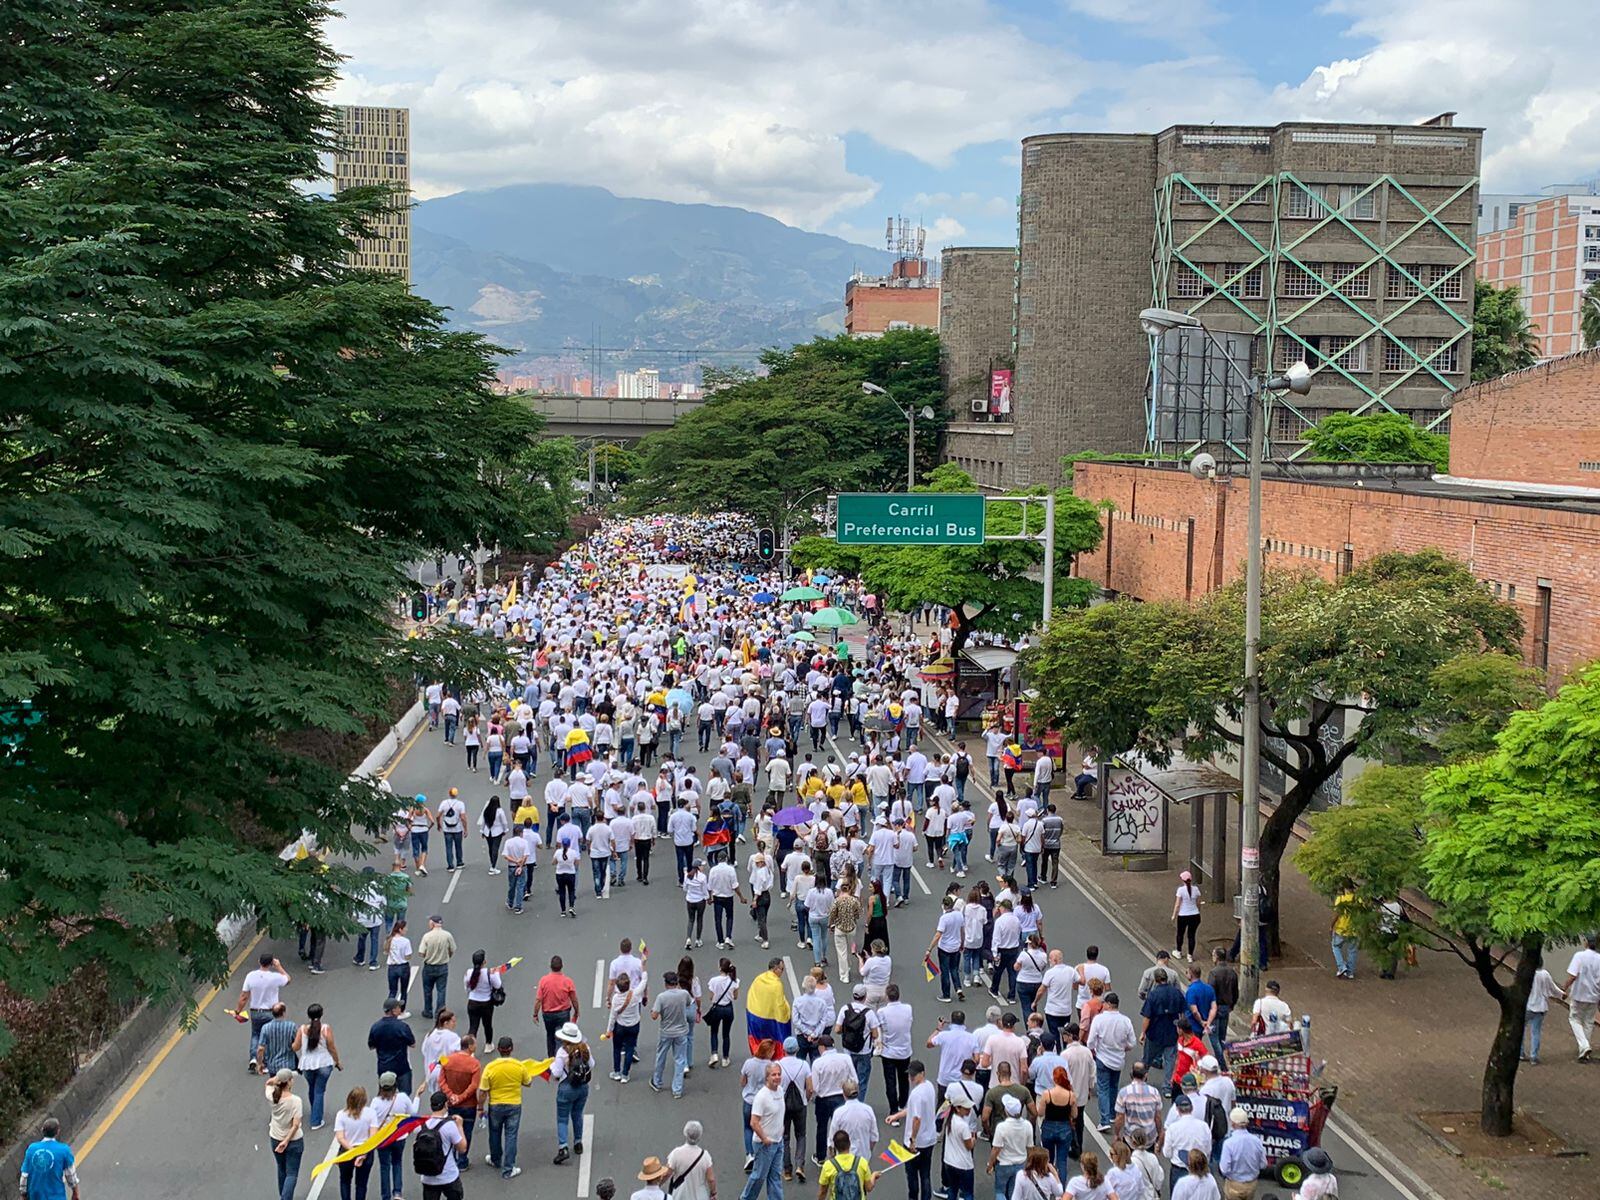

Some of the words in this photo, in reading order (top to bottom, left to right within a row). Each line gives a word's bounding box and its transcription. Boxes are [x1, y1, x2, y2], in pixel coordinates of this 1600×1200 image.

[888, 503, 934, 516] Carril
[844, 523, 939, 537] Preferencial
[946, 523, 976, 537] Bus
[1256, 1112, 1267, 1120] DE
[1269, 1113, 1298, 1123] LOCOS
[1260, 1134, 1301, 1149] LADAS
